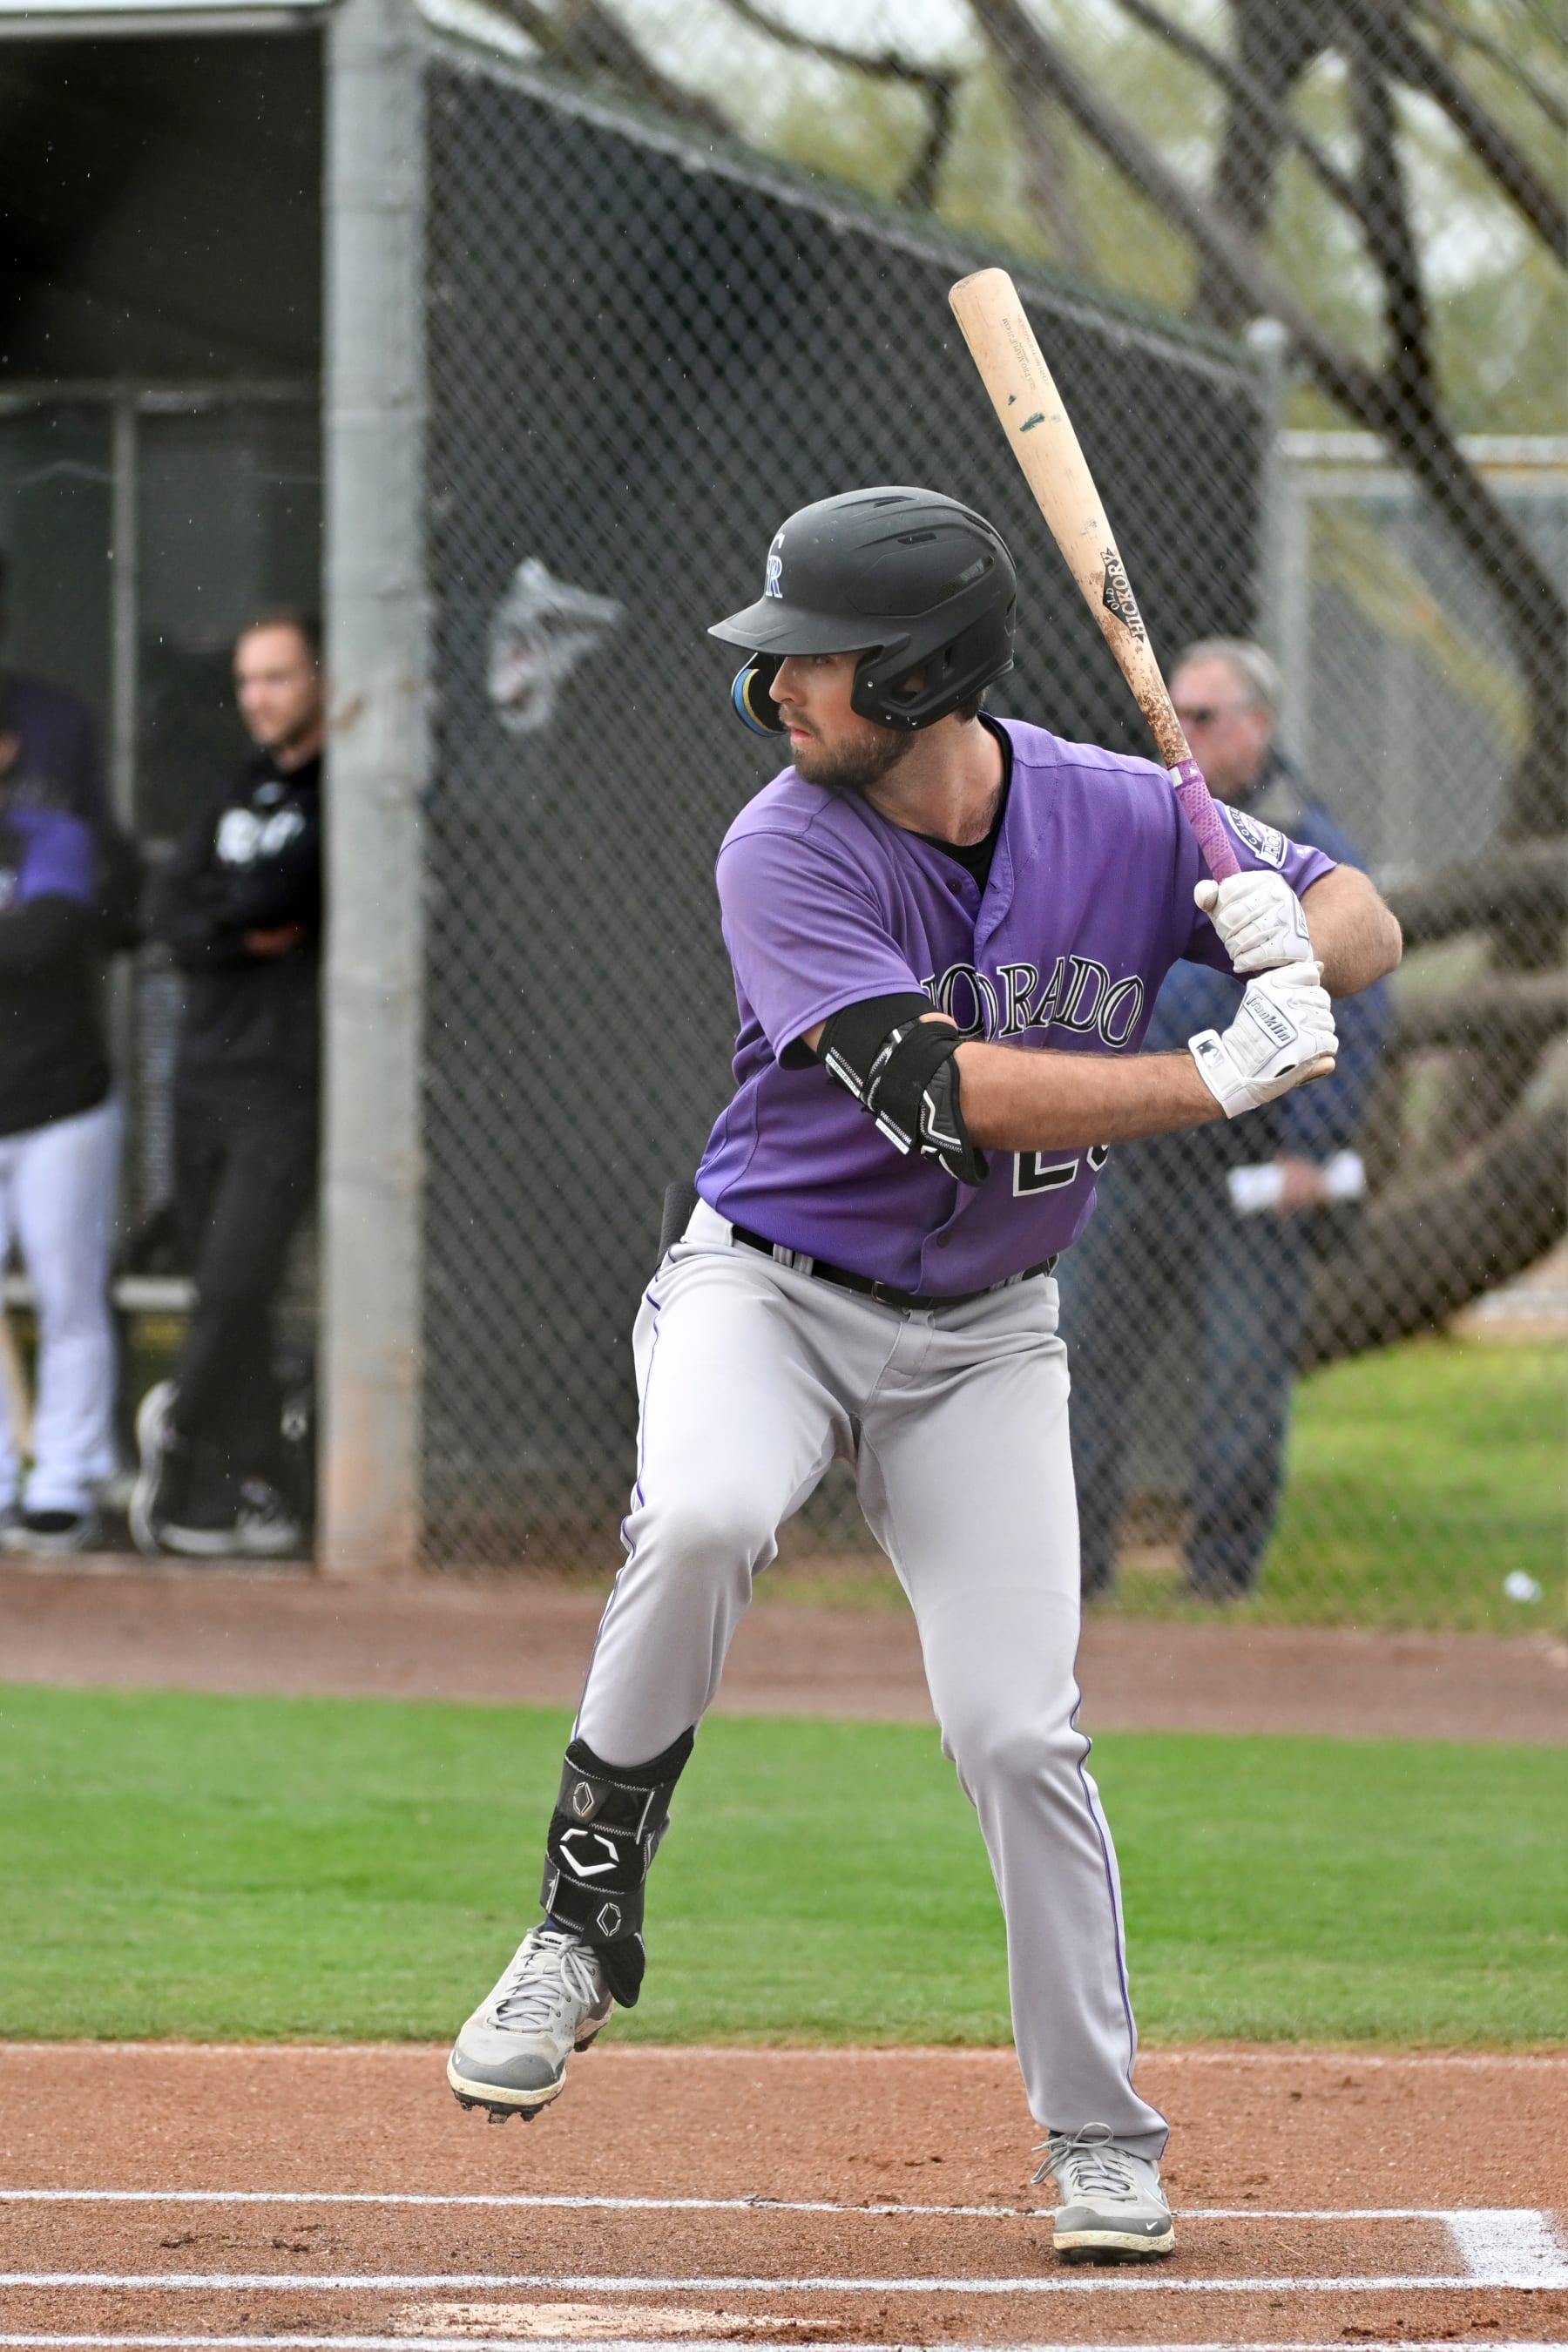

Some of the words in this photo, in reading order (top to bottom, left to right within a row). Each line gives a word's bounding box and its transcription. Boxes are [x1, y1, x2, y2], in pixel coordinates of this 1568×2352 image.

[1100, 548, 1147, 639] HICKORY
[1105, 587, 1120, 611] OLD
[1246, 994, 1291, 1042] Franklin
[828, 1057, 859, 1093] EVOSHIELD
